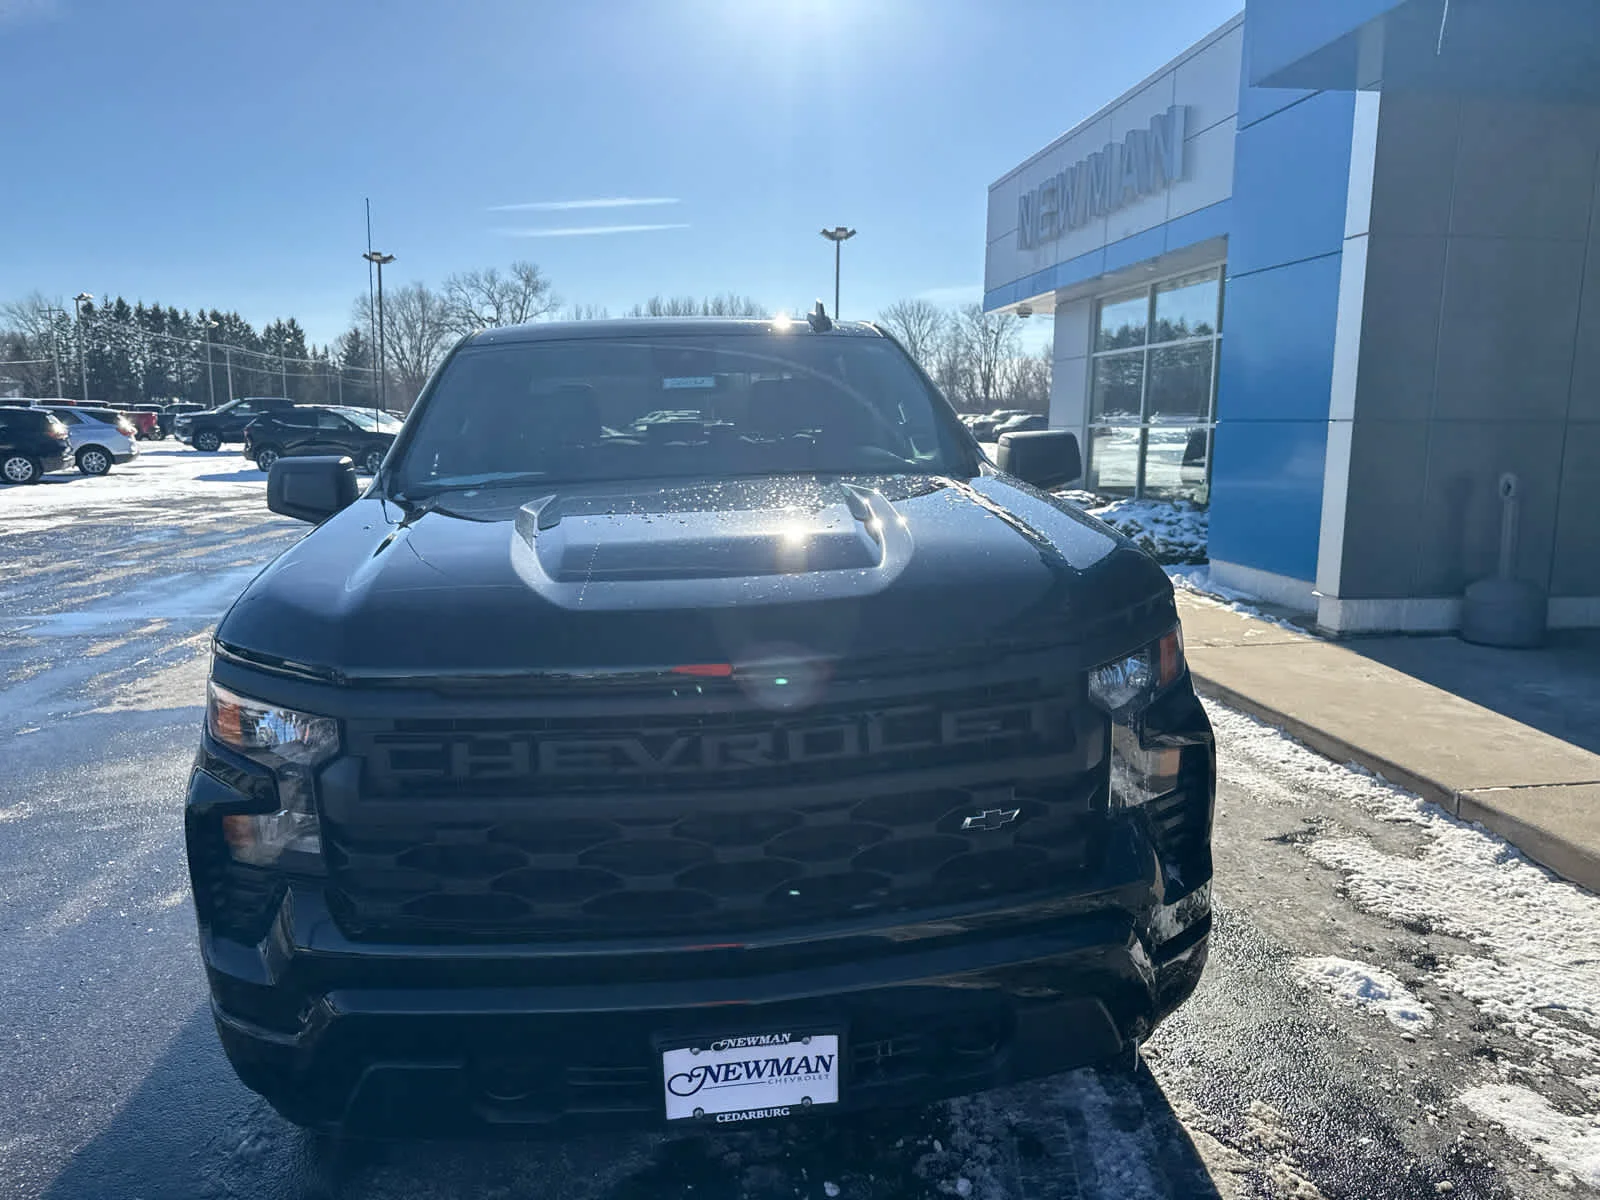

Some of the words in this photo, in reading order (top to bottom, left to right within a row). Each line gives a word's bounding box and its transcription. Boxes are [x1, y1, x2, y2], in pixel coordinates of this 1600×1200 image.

[1018, 105, 1190, 250] NEWMAN
[370, 700, 1058, 779] CHEVROLET
[711, 1033, 791, 1051] NEWMAN
[667, 1054, 835, 1097] NEWMAN
[767, 1074, 831, 1085] CHEVROLET
[716, 1107, 791, 1123] CEDARBURG
